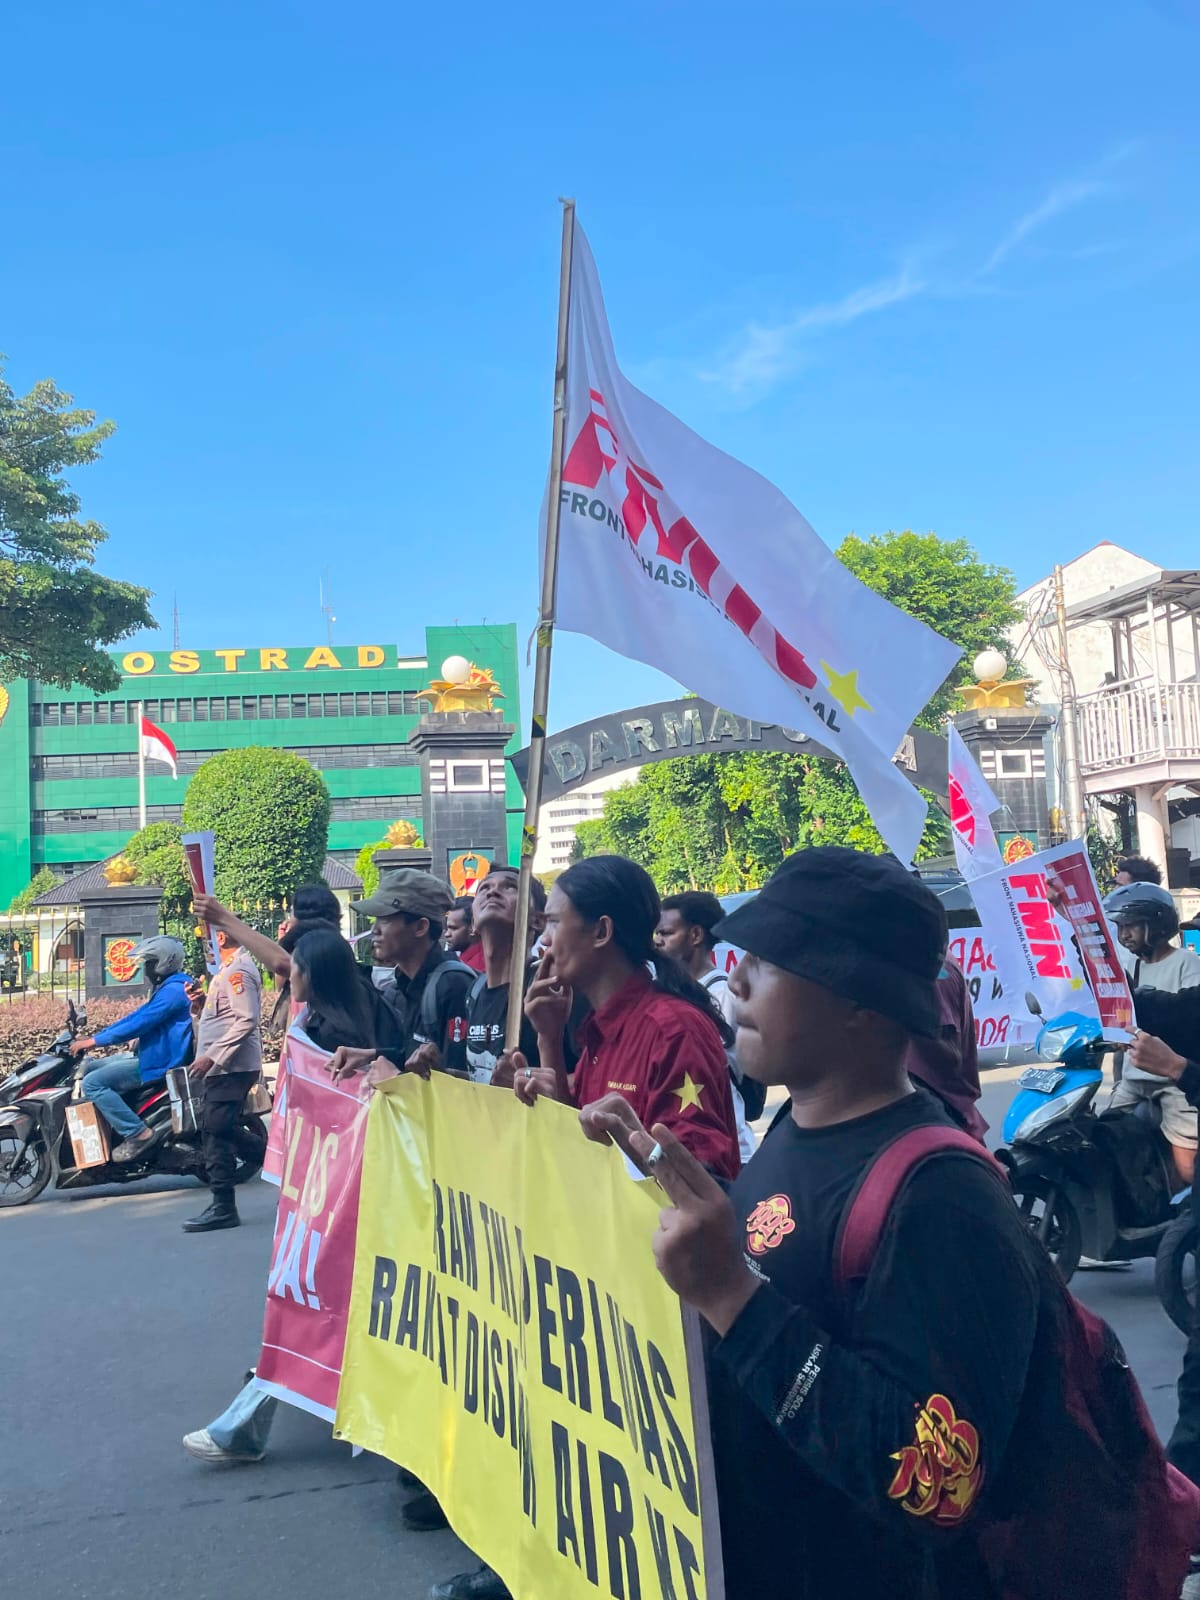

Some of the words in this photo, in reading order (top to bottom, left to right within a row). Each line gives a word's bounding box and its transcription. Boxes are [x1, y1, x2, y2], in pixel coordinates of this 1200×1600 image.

[122, 646, 386, 675] OSTRAD
[1001, 877, 1012, 900] FRONT
[1008, 901, 1026, 943] MAHASISWA
[1023, 943, 1038, 980] NASIONAL
[1008, 873, 1072, 979] FMN
[787, 1394, 804, 1418] SOLO
[551, 1419, 642, 1600] AIR
